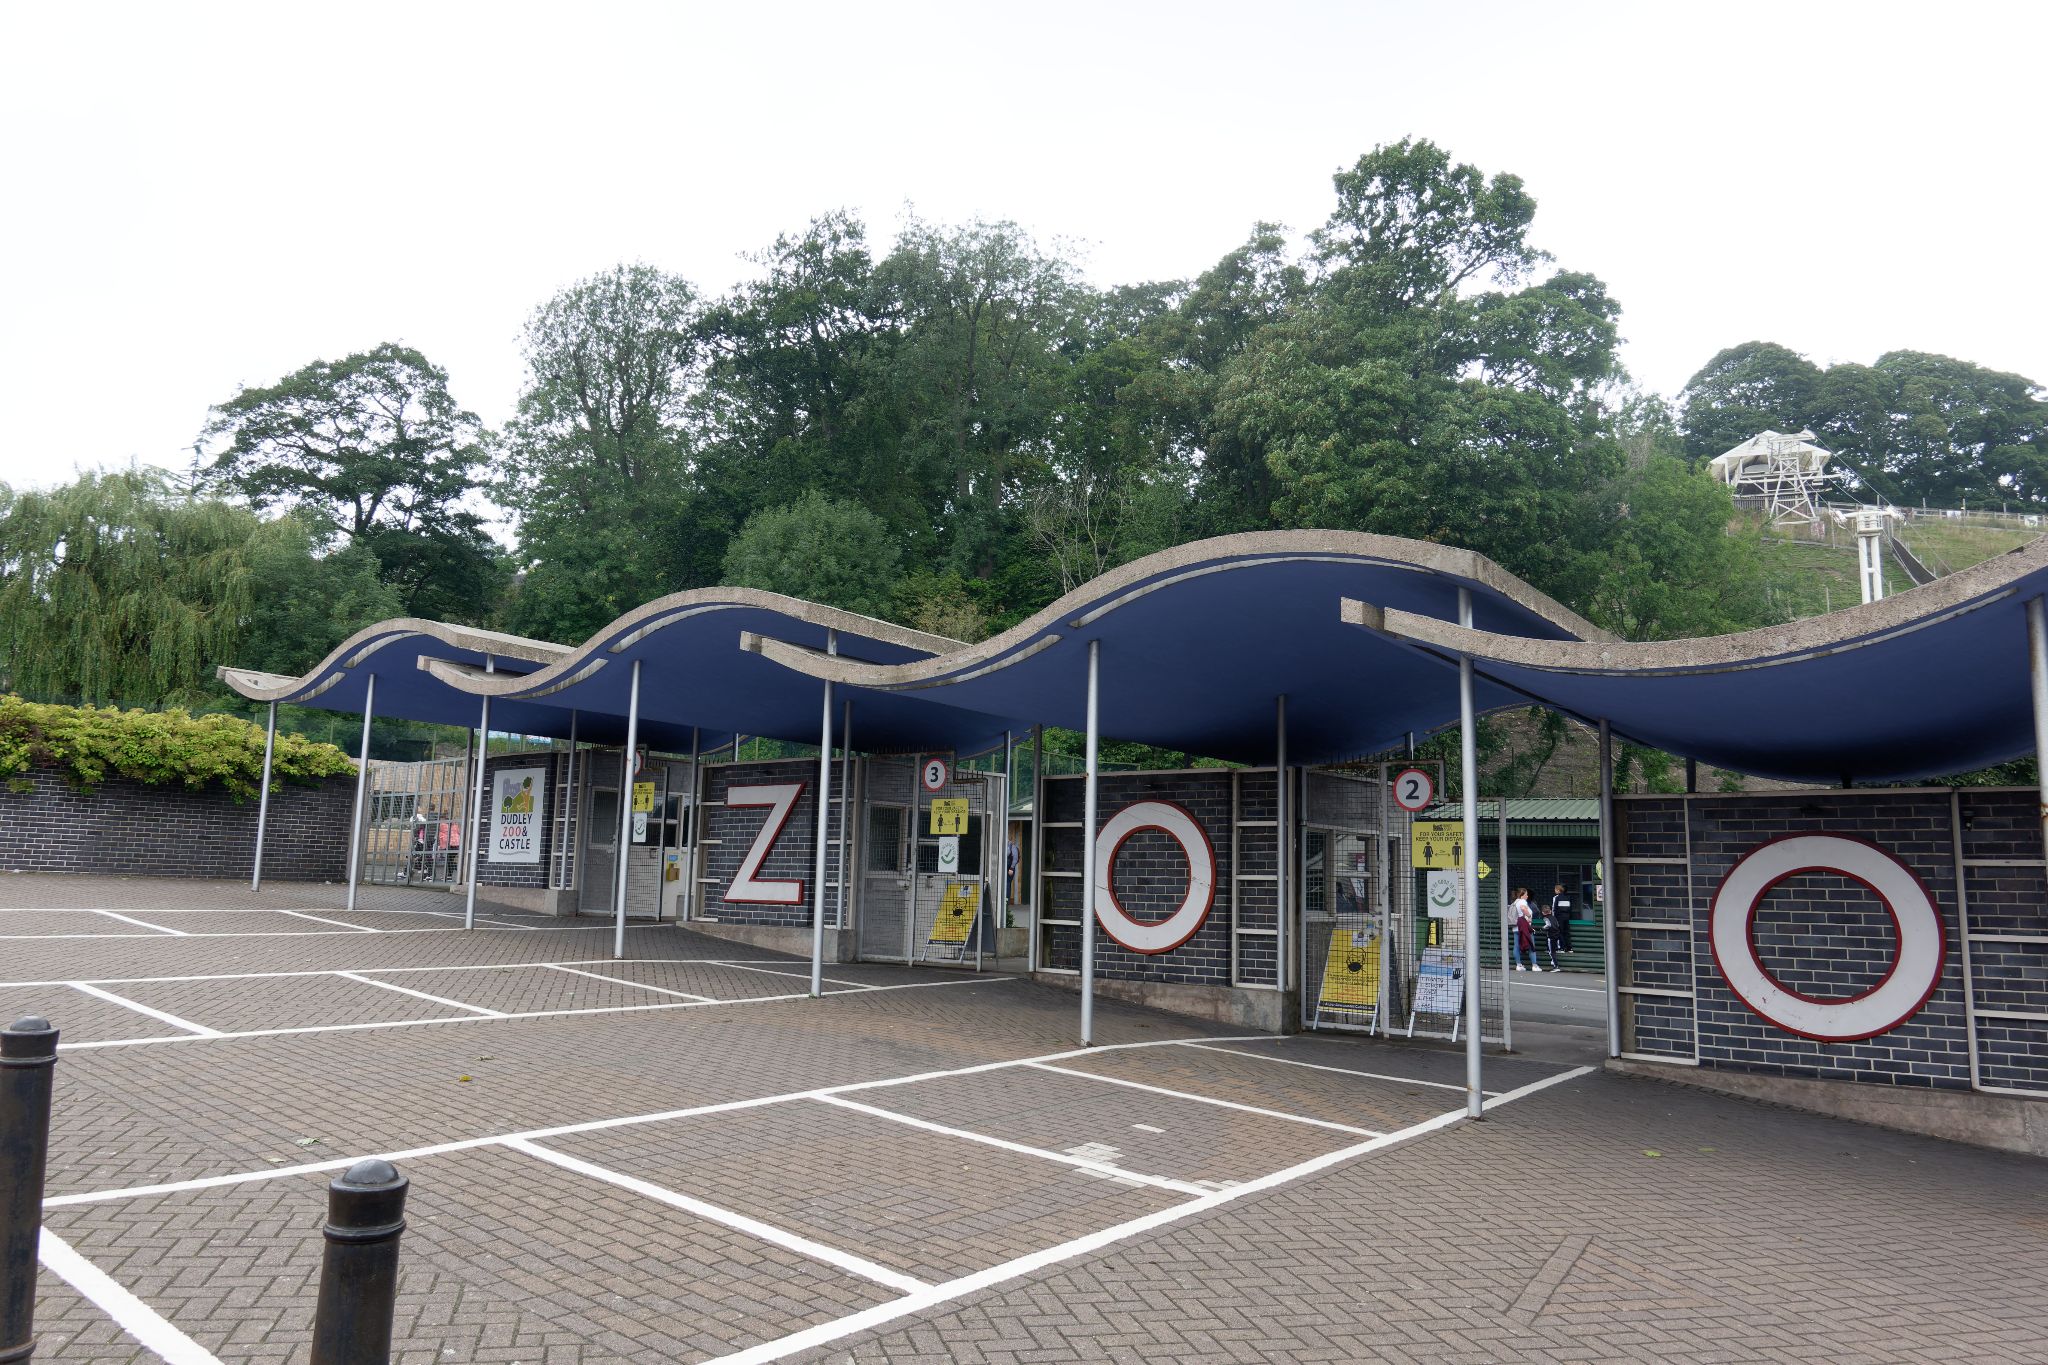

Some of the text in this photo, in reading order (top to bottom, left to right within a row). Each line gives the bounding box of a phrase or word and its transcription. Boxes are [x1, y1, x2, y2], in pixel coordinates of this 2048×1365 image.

[930, 767, 938, 782] 3
[1405, 779, 1419, 800] 2
[500, 813, 533, 825] DUDLEY
[499, 838, 531, 850] CASTLE
[723, 781, 807, 905] Z
[1708, 831, 1946, 1042] O
